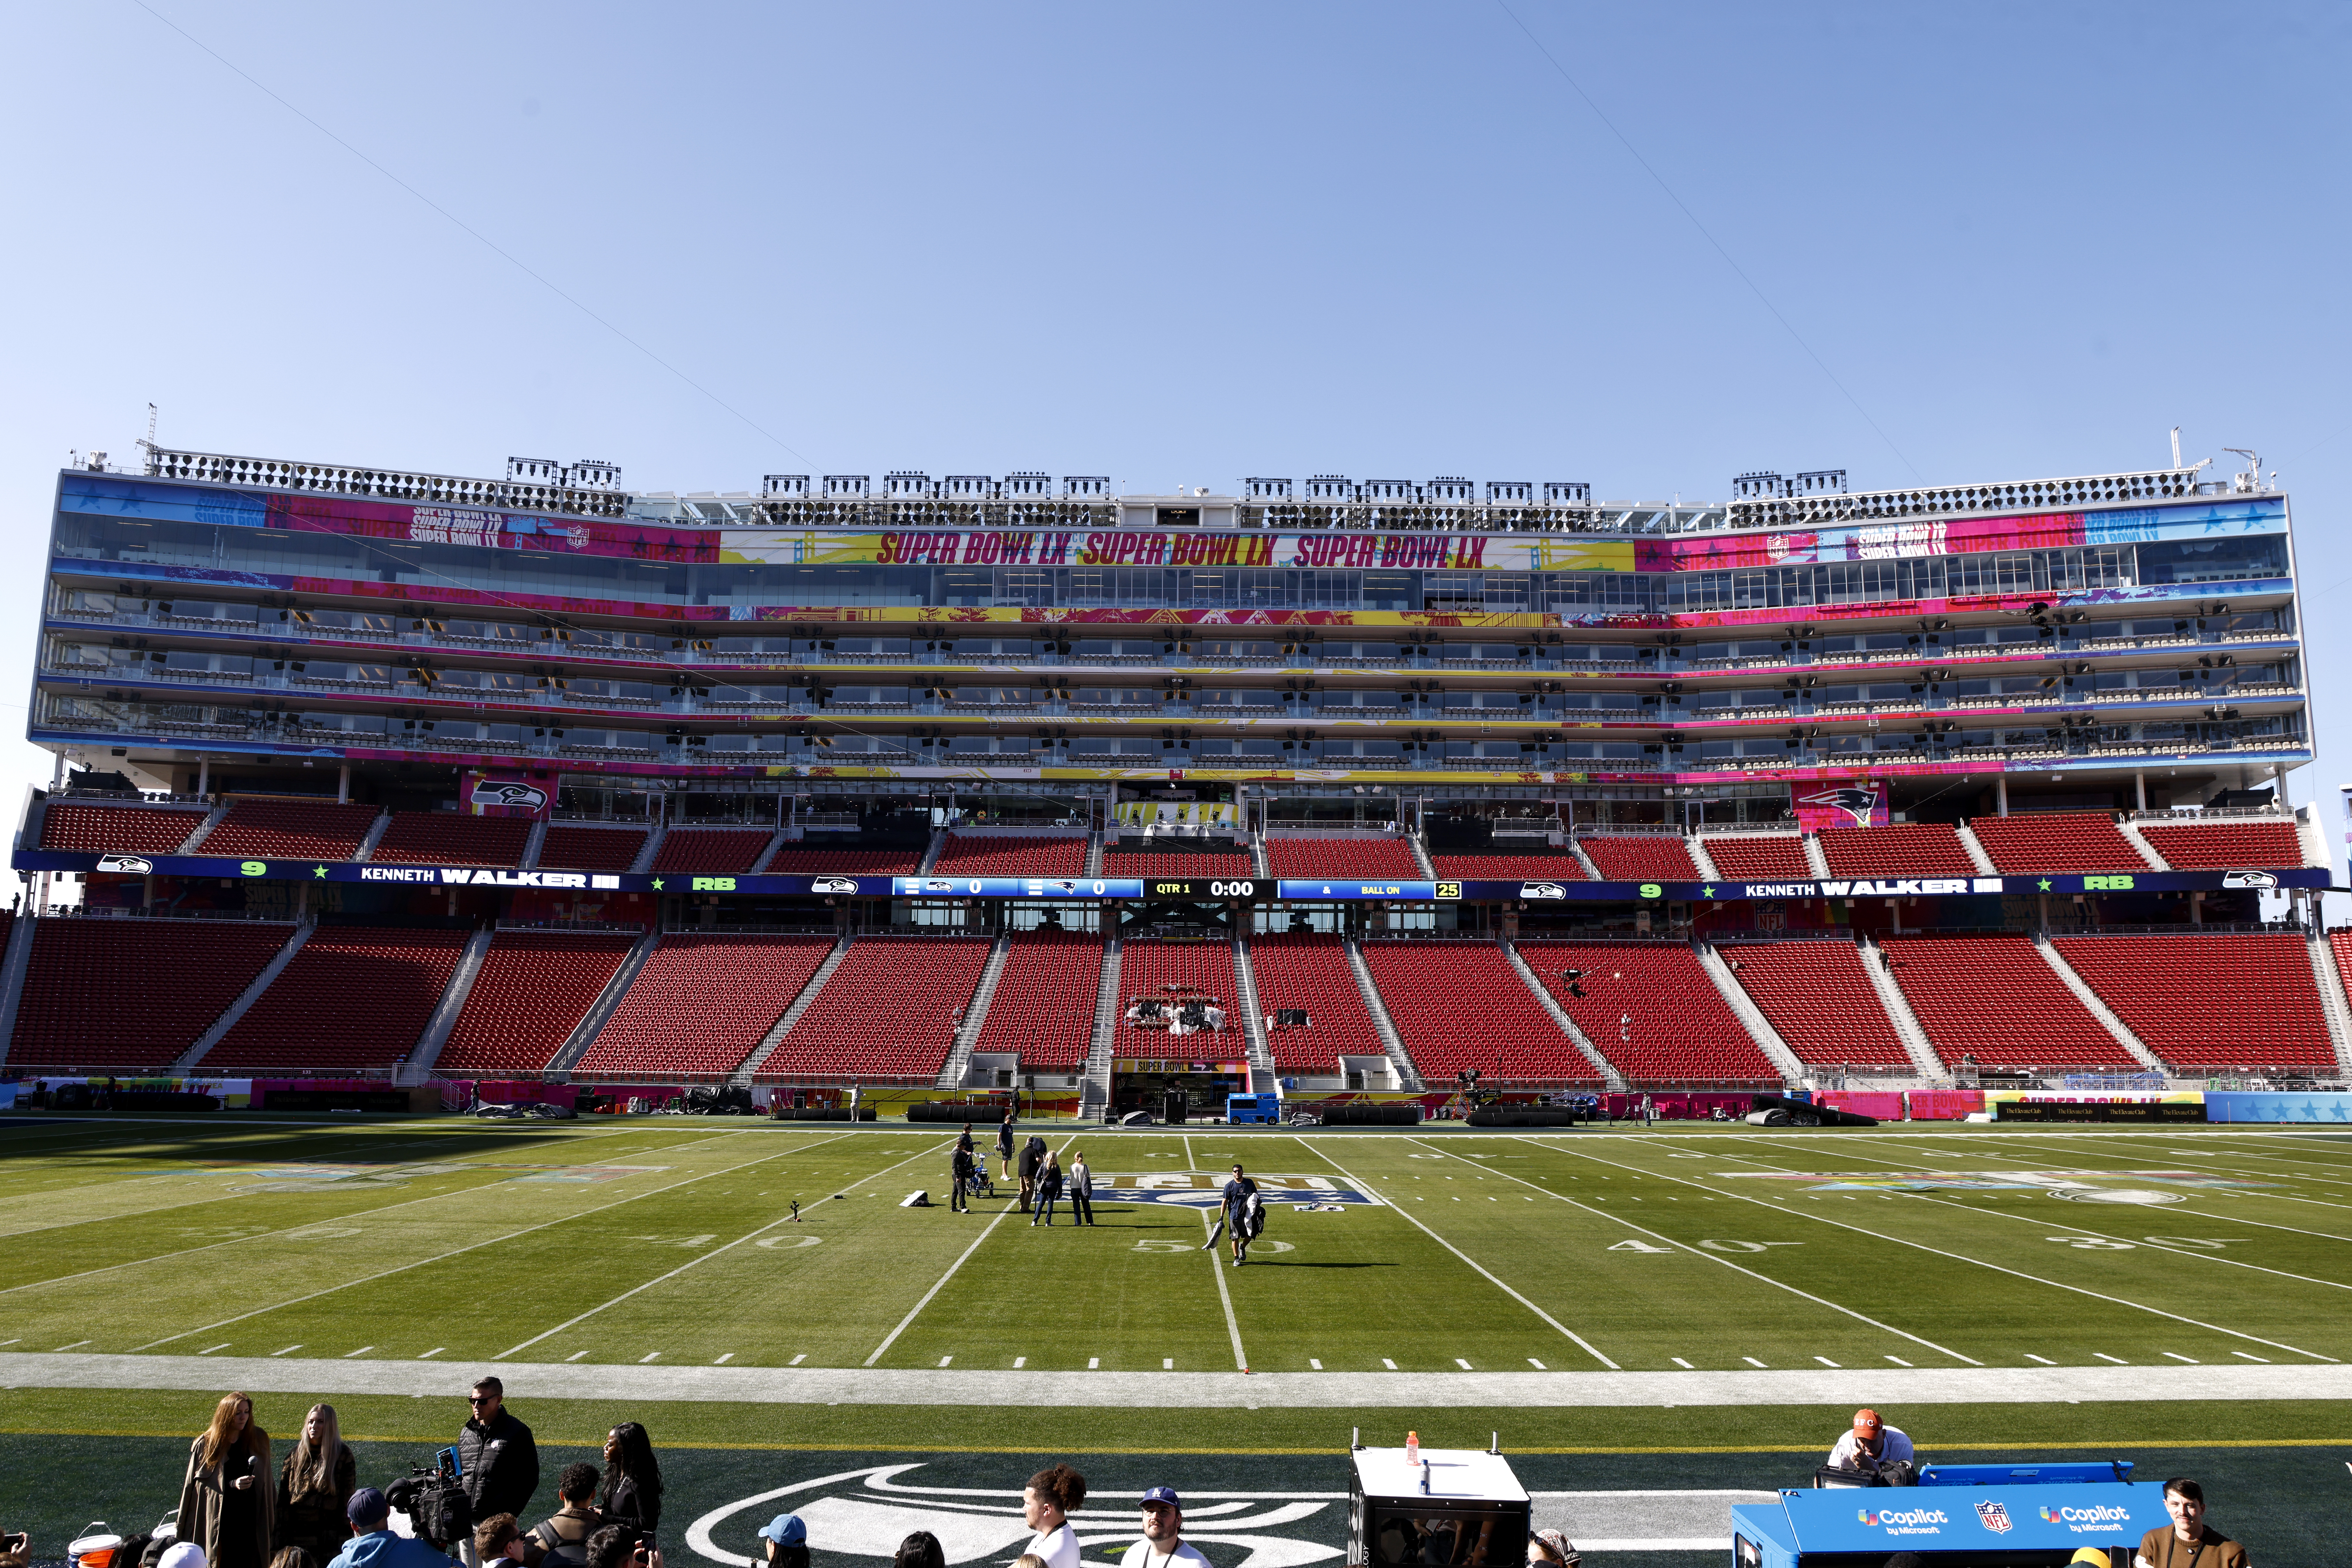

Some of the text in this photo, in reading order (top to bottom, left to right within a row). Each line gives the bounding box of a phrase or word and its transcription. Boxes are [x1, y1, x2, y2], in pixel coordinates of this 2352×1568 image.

[410, 514, 503, 535] SUPER BOWL LX
[2067, 516, 2159, 534] SUPER BOWL LX
[569, 534, 587, 546] NFL
[1857, 528, 1947, 547] SUPER BOWL LX
[876, 532, 1072, 564] SUPER BOWL LX
[1083, 532, 1279, 566] SUPER BOWL LX
[1294, 535, 1488, 569] SUPER BOWL LX
[1769, 547, 1787, 556] NFL
[419, 586, 480, 599] BAY AREA
[241, 861, 267, 876] 9
[361, 868, 620, 889] KENNETH WALKER III
[692, 878, 737, 890] RB
[2084, 875, 2134, 890] RB
[969, 880, 982, 893] 0
[1093, 881, 1105, 894] 0
[1156, 884, 1190, 894] QTR 1
[1211, 881, 1254, 896] 0:00
[1323, 886, 1331, 894] &
[1438, 884, 1458, 896] 25
[1639, 884, 1662, 898] 9
[1746, 879, 2003, 897] KENNETH WALKER III
[244, 885, 343, 905] SUPER BWL LX
[2001, 899, 2100, 918] SUPE BOWL LX
[1758, 914, 1783, 930] NFL
[1138, 1061, 1220, 1071] SUPER BOWL LX
[1855, 1418, 1874, 1427] EFC
[1879, 1508, 1948, 1527] Copilot
[2061, 1505, 2130, 1523] Copilot
[1983, 1515, 2009, 1529] NFL
[2069, 1523, 2123, 1533] by Microsoft
[1886, 1526, 1940, 1535] by Microsoft
